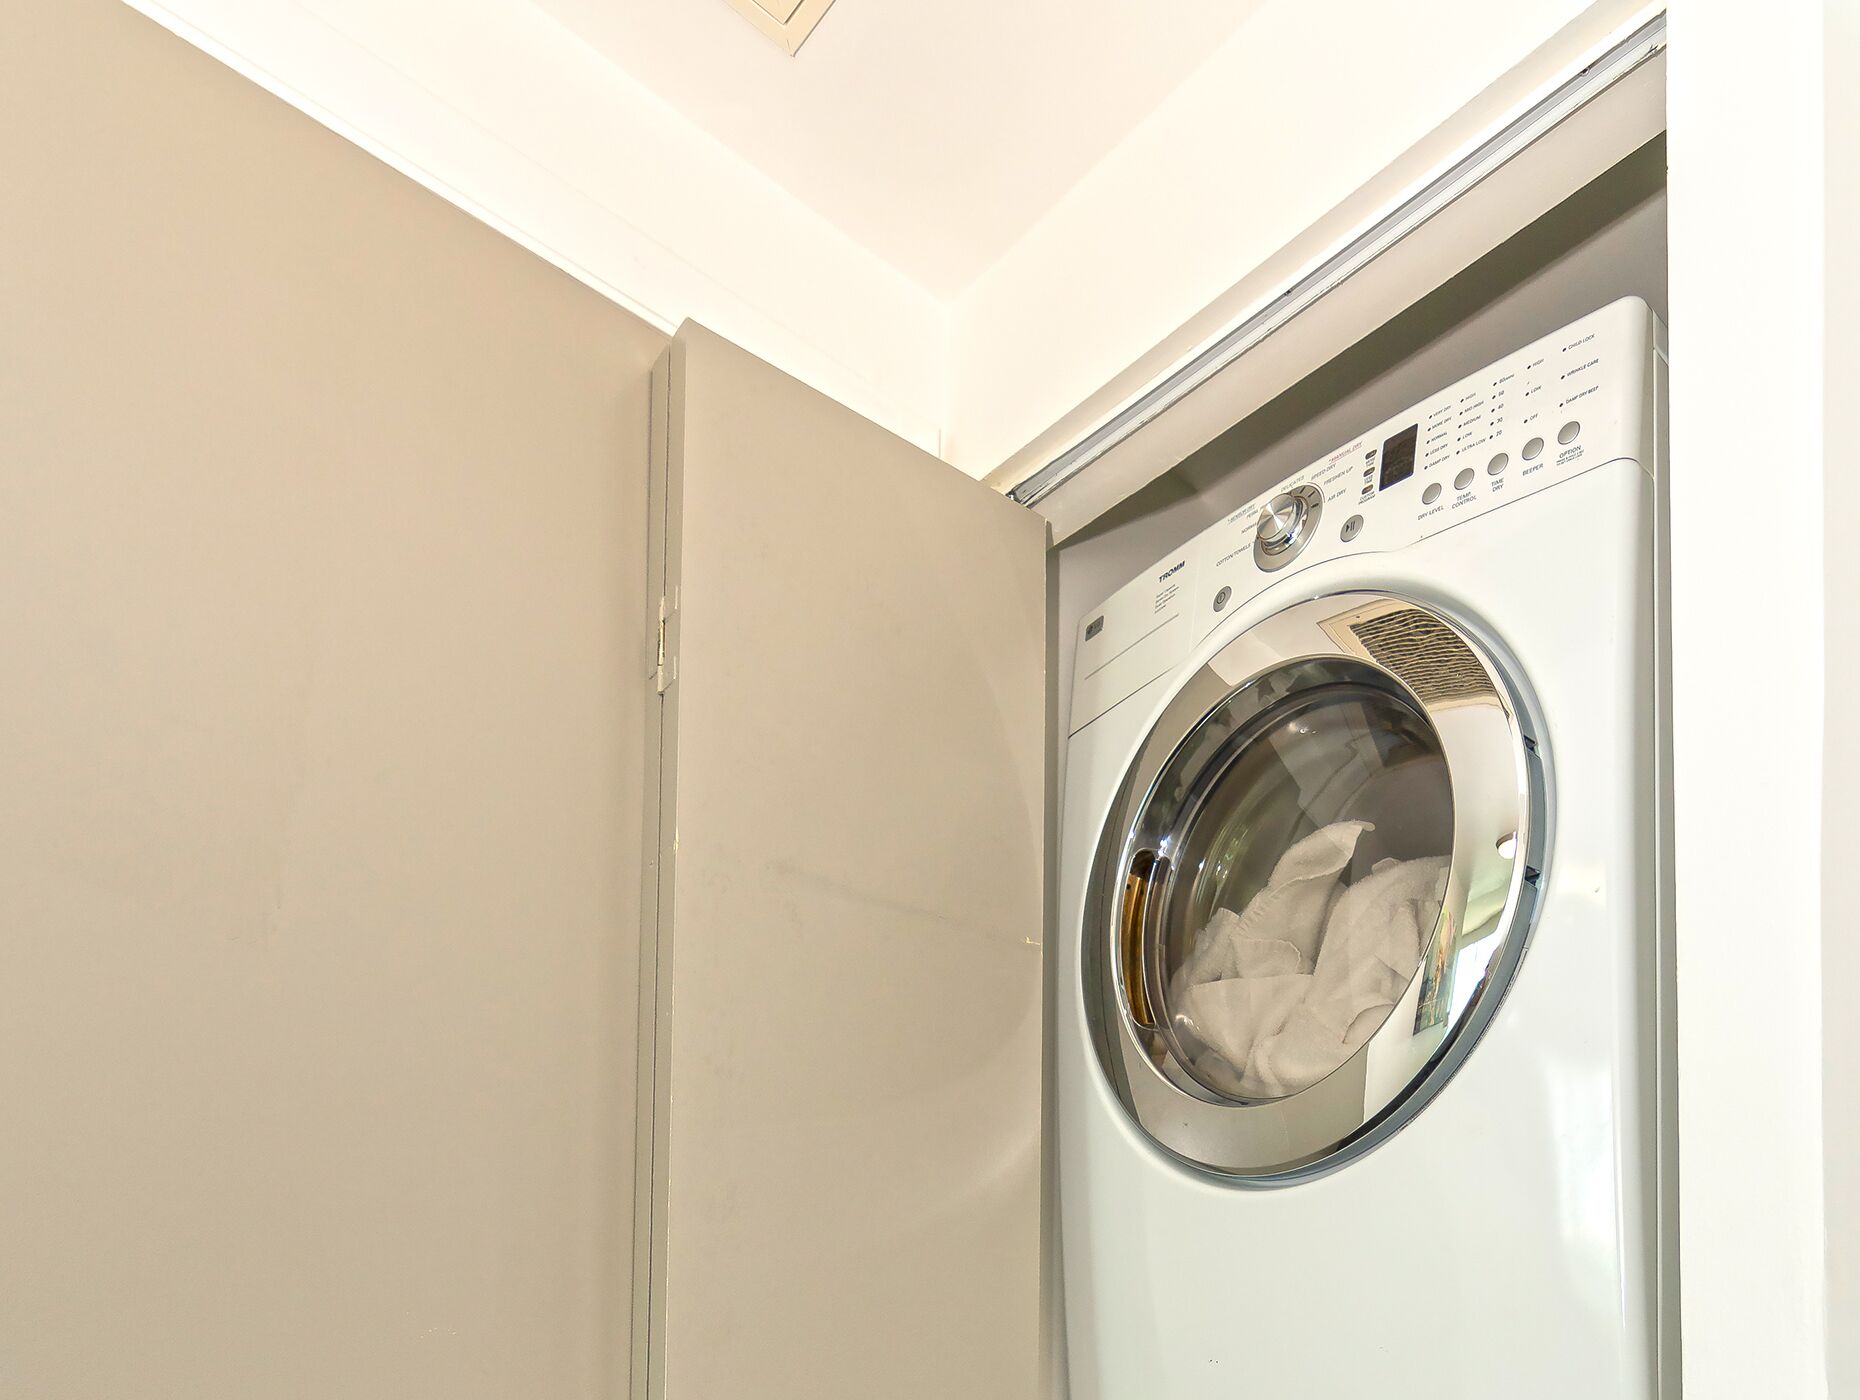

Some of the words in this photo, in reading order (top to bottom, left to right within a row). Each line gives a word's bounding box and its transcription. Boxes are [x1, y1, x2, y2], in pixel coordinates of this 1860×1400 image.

[1559, 444, 1582, 458] OPTION
[1522, 463, 1544, 476] BEEPER
[1492, 477, 1504, 487] TIME
[1492, 484, 1504, 492] DRY
[1452, 495, 1477, 509] CONTROL
[1418, 511, 1429, 521] DRY
[1429, 505, 1444, 516] LEVEL
[1159, 560, 1186, 583] TROMM
